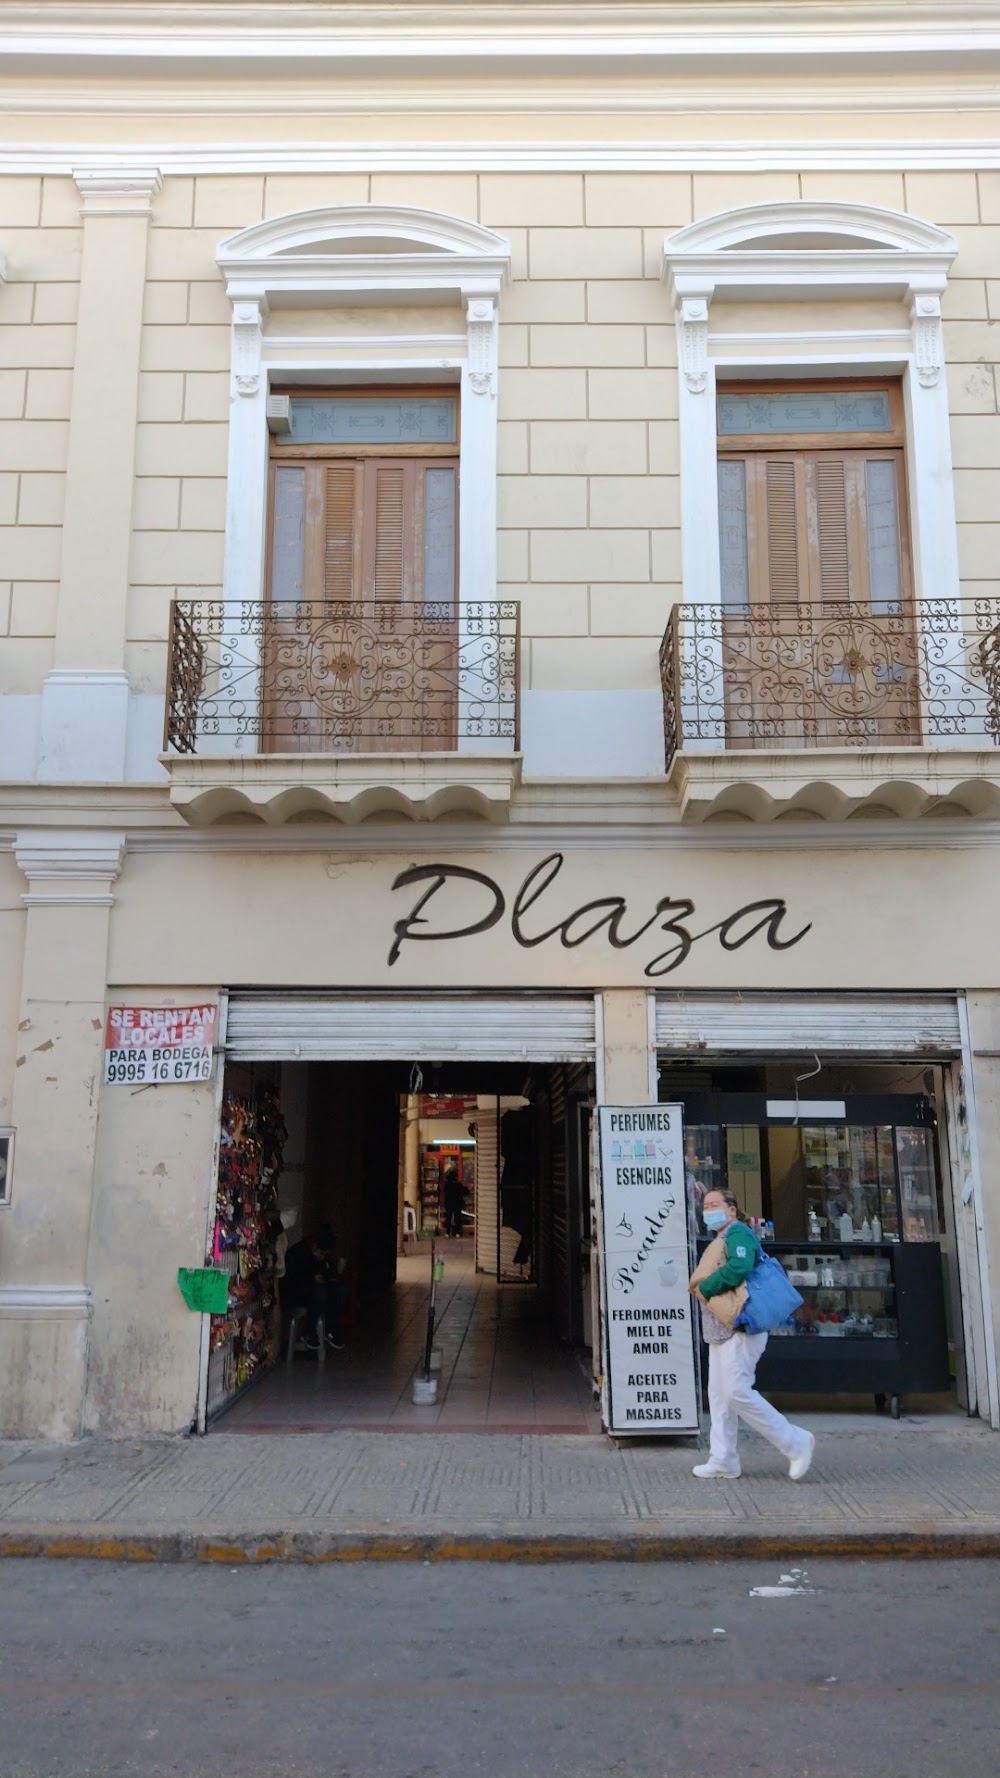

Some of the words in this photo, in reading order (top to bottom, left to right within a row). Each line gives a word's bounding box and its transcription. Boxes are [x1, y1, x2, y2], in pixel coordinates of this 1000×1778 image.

[388, 853, 812, 977] Plaza
[111, 1009, 134, 1027] SE
[139, 1007, 216, 1027] RENTAN
[119, 1026, 204, 1045] LOCALES
[109, 1049, 147, 1062] PARA
[152, 1047, 209, 1060] BODEGA
[107, 1064, 146, 1082] 9995
[151, 1063, 169, 1079] 16
[174, 1061, 210, 1079] 6716
[610, 1113, 671, 1132] PERFUMES
[616, 1167, 672, 1186] ESENCIAS
[612, 1193, 676, 1294] Pecados
[612, 1309, 685, 1321] FEROMONAS
[627, 1326, 655, 1338] MIEL
[657, 1325, 672, 1337] DE
[633, 1342, 669, 1354] AMOR
[628, 1374, 677, 1386] ACEITES
[637, 1391, 669, 1403] PARA
[626, 1408, 682, 1421] MASAJES
